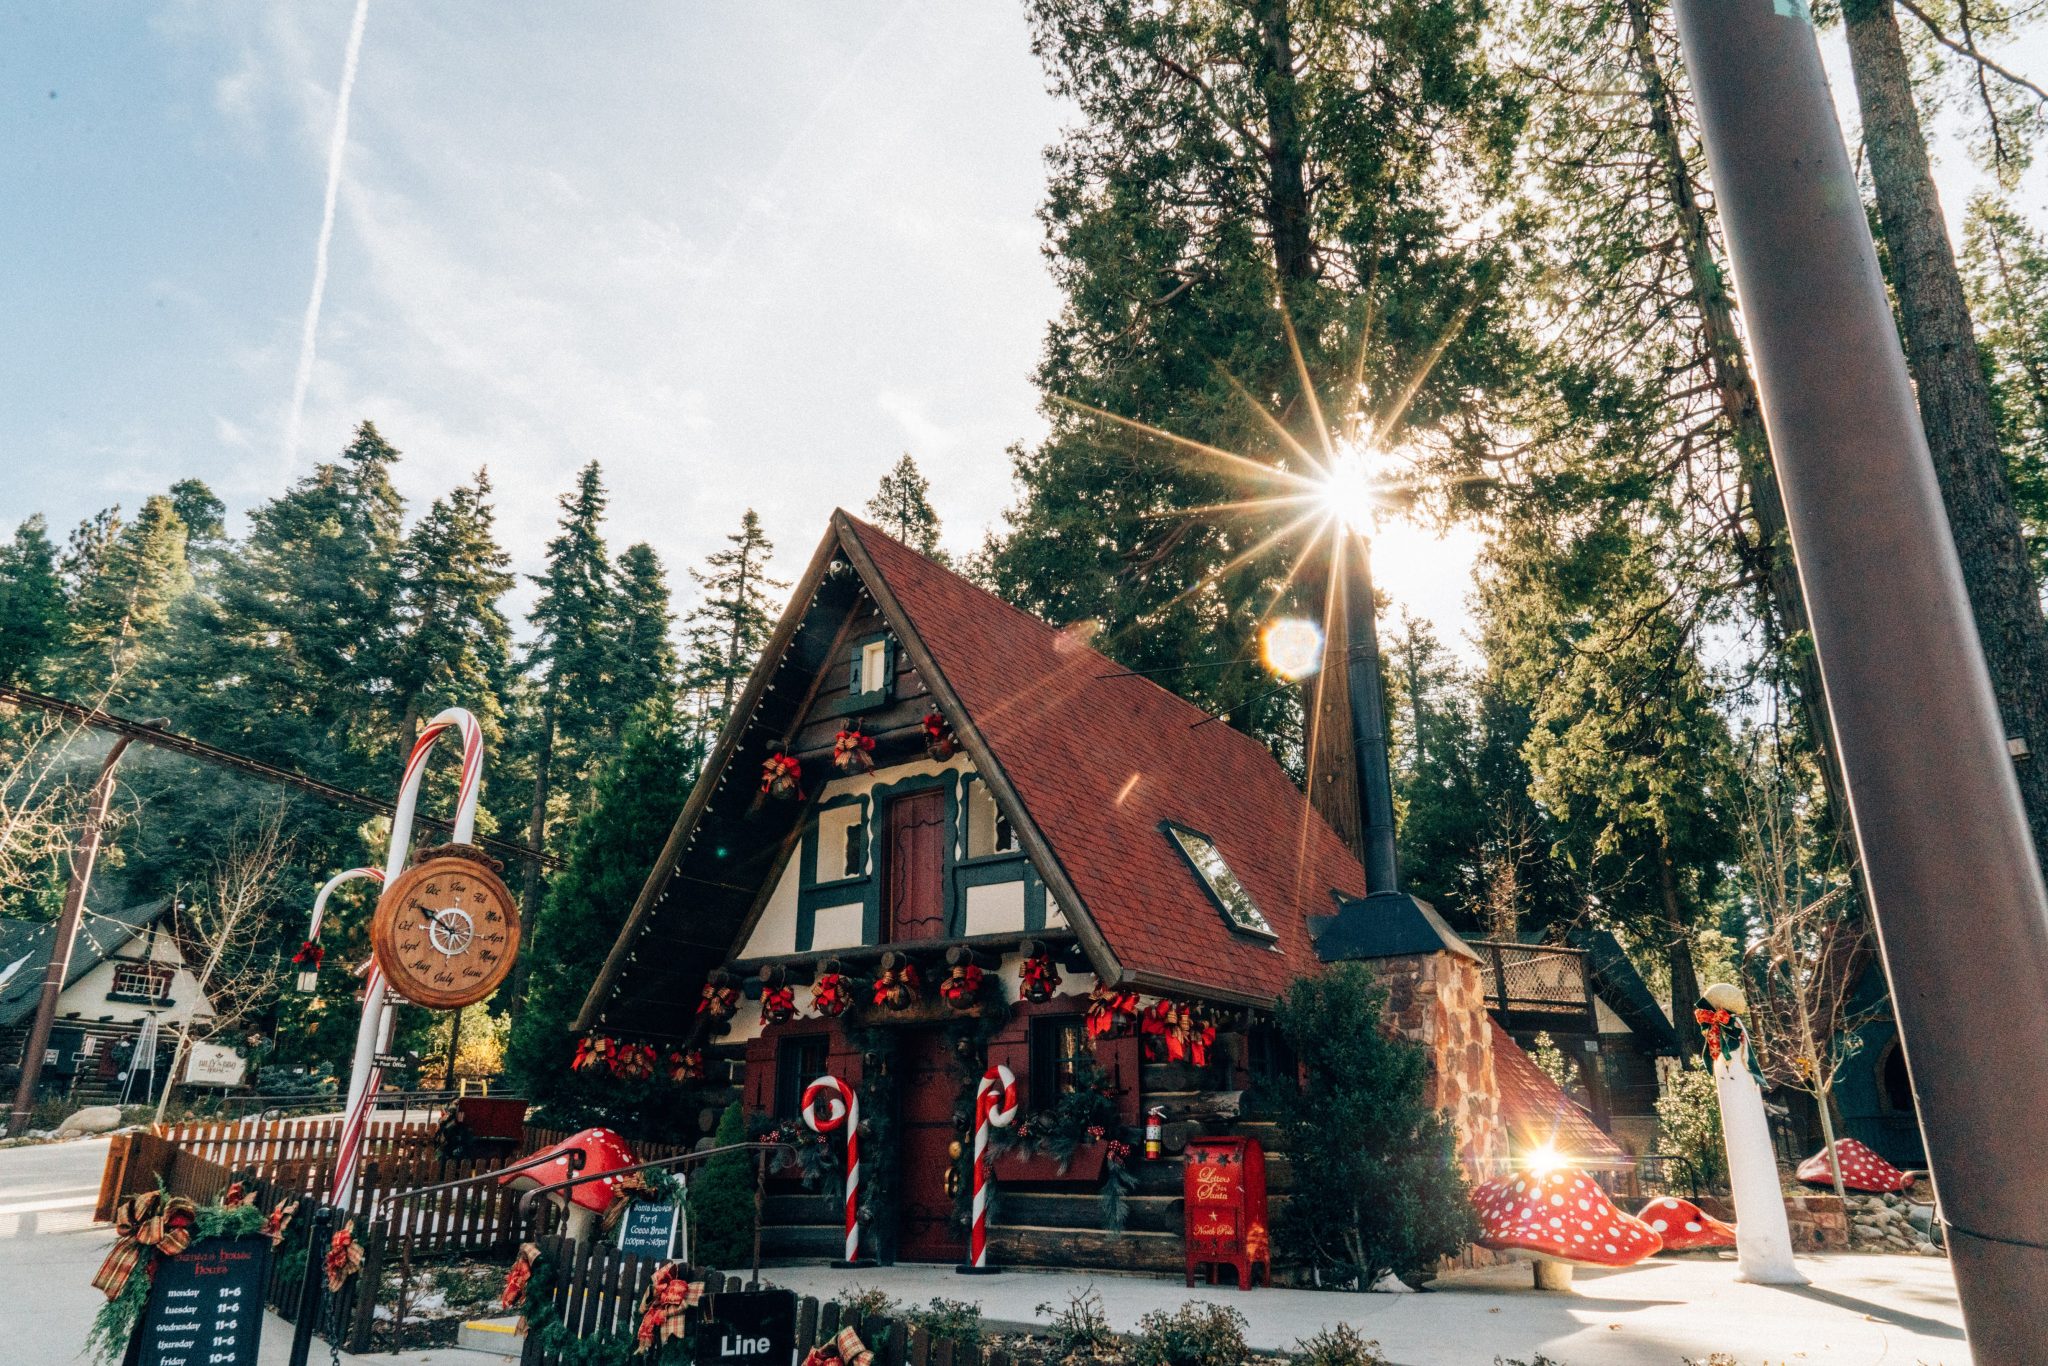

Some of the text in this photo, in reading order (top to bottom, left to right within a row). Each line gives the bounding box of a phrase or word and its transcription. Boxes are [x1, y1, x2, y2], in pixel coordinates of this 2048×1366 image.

[425, 883, 441, 896] Dec
[450, 881, 466, 893] Jan
[473, 892, 488, 904] Feb
[485, 910, 502, 923] Mar
[398, 920, 414, 931] Oct
[483, 933, 504, 945] Apr
[400, 939, 420, 954] Sept
[479, 949, 498, 965] May
[409, 960, 431, 974] Aug
[462, 966, 483, 978] June
[433, 971, 455, 986] July
[1197, 1166, 1230, 1183] Letters
[1197, 1183, 1228, 1202] Santa
[640, 1214, 650, 1223] For
[630, 1225, 668, 1235] Cocoa Break
[1193, 1224, 1234, 1236] North Pole
[167, 1287, 241, 1298] monday 11-6
[165, 1302, 240, 1315] tuesday 11-6
[156, 1319, 238, 1332] wednesday 11-6
[157, 1335, 235, 1350] thursday 11-6
[721, 1335, 771, 1356] Line
[160, 1352, 235, 1366] friday 10-6
